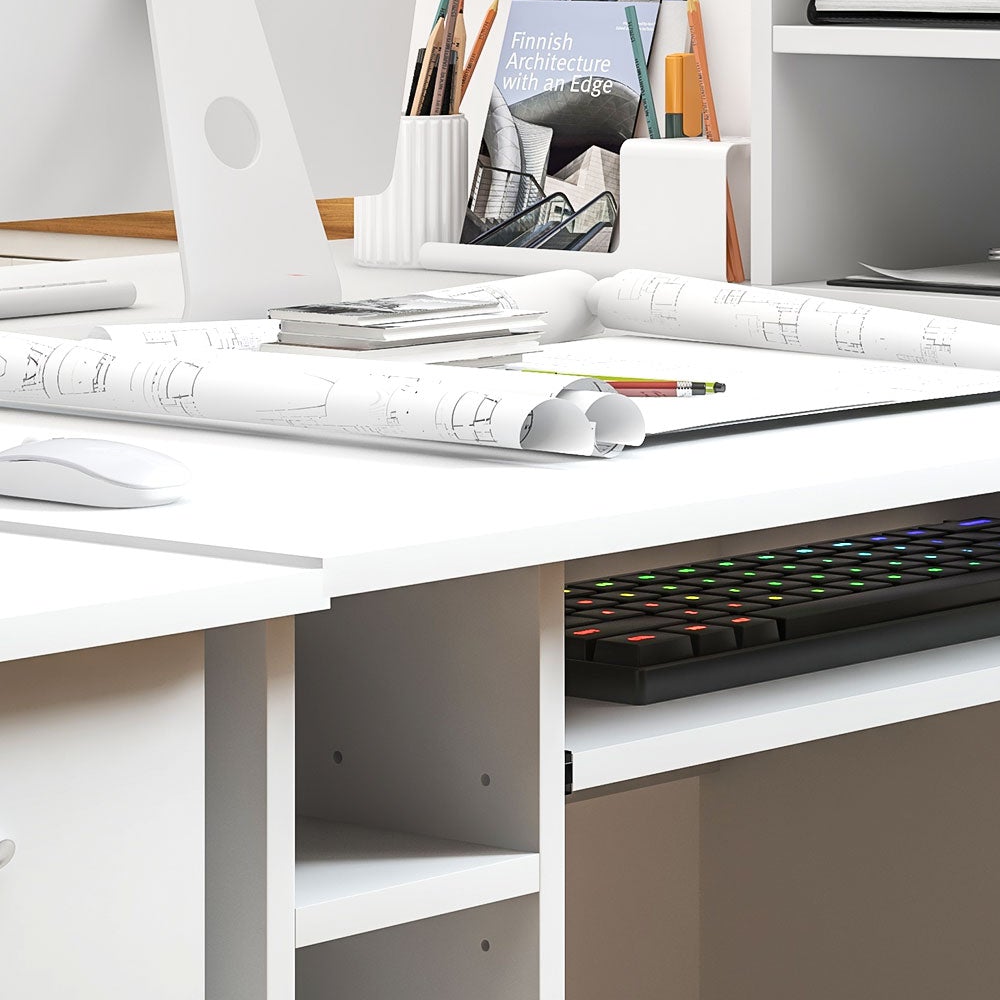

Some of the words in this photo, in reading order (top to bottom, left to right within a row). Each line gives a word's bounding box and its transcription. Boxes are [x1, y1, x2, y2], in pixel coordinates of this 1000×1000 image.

[510, 31, 573, 50] Finnish
[505, 52, 611, 73] Architecture
[502, 74, 538, 91] with
[543, 79, 565, 93] an
[569, 76, 613, 98] Edge
